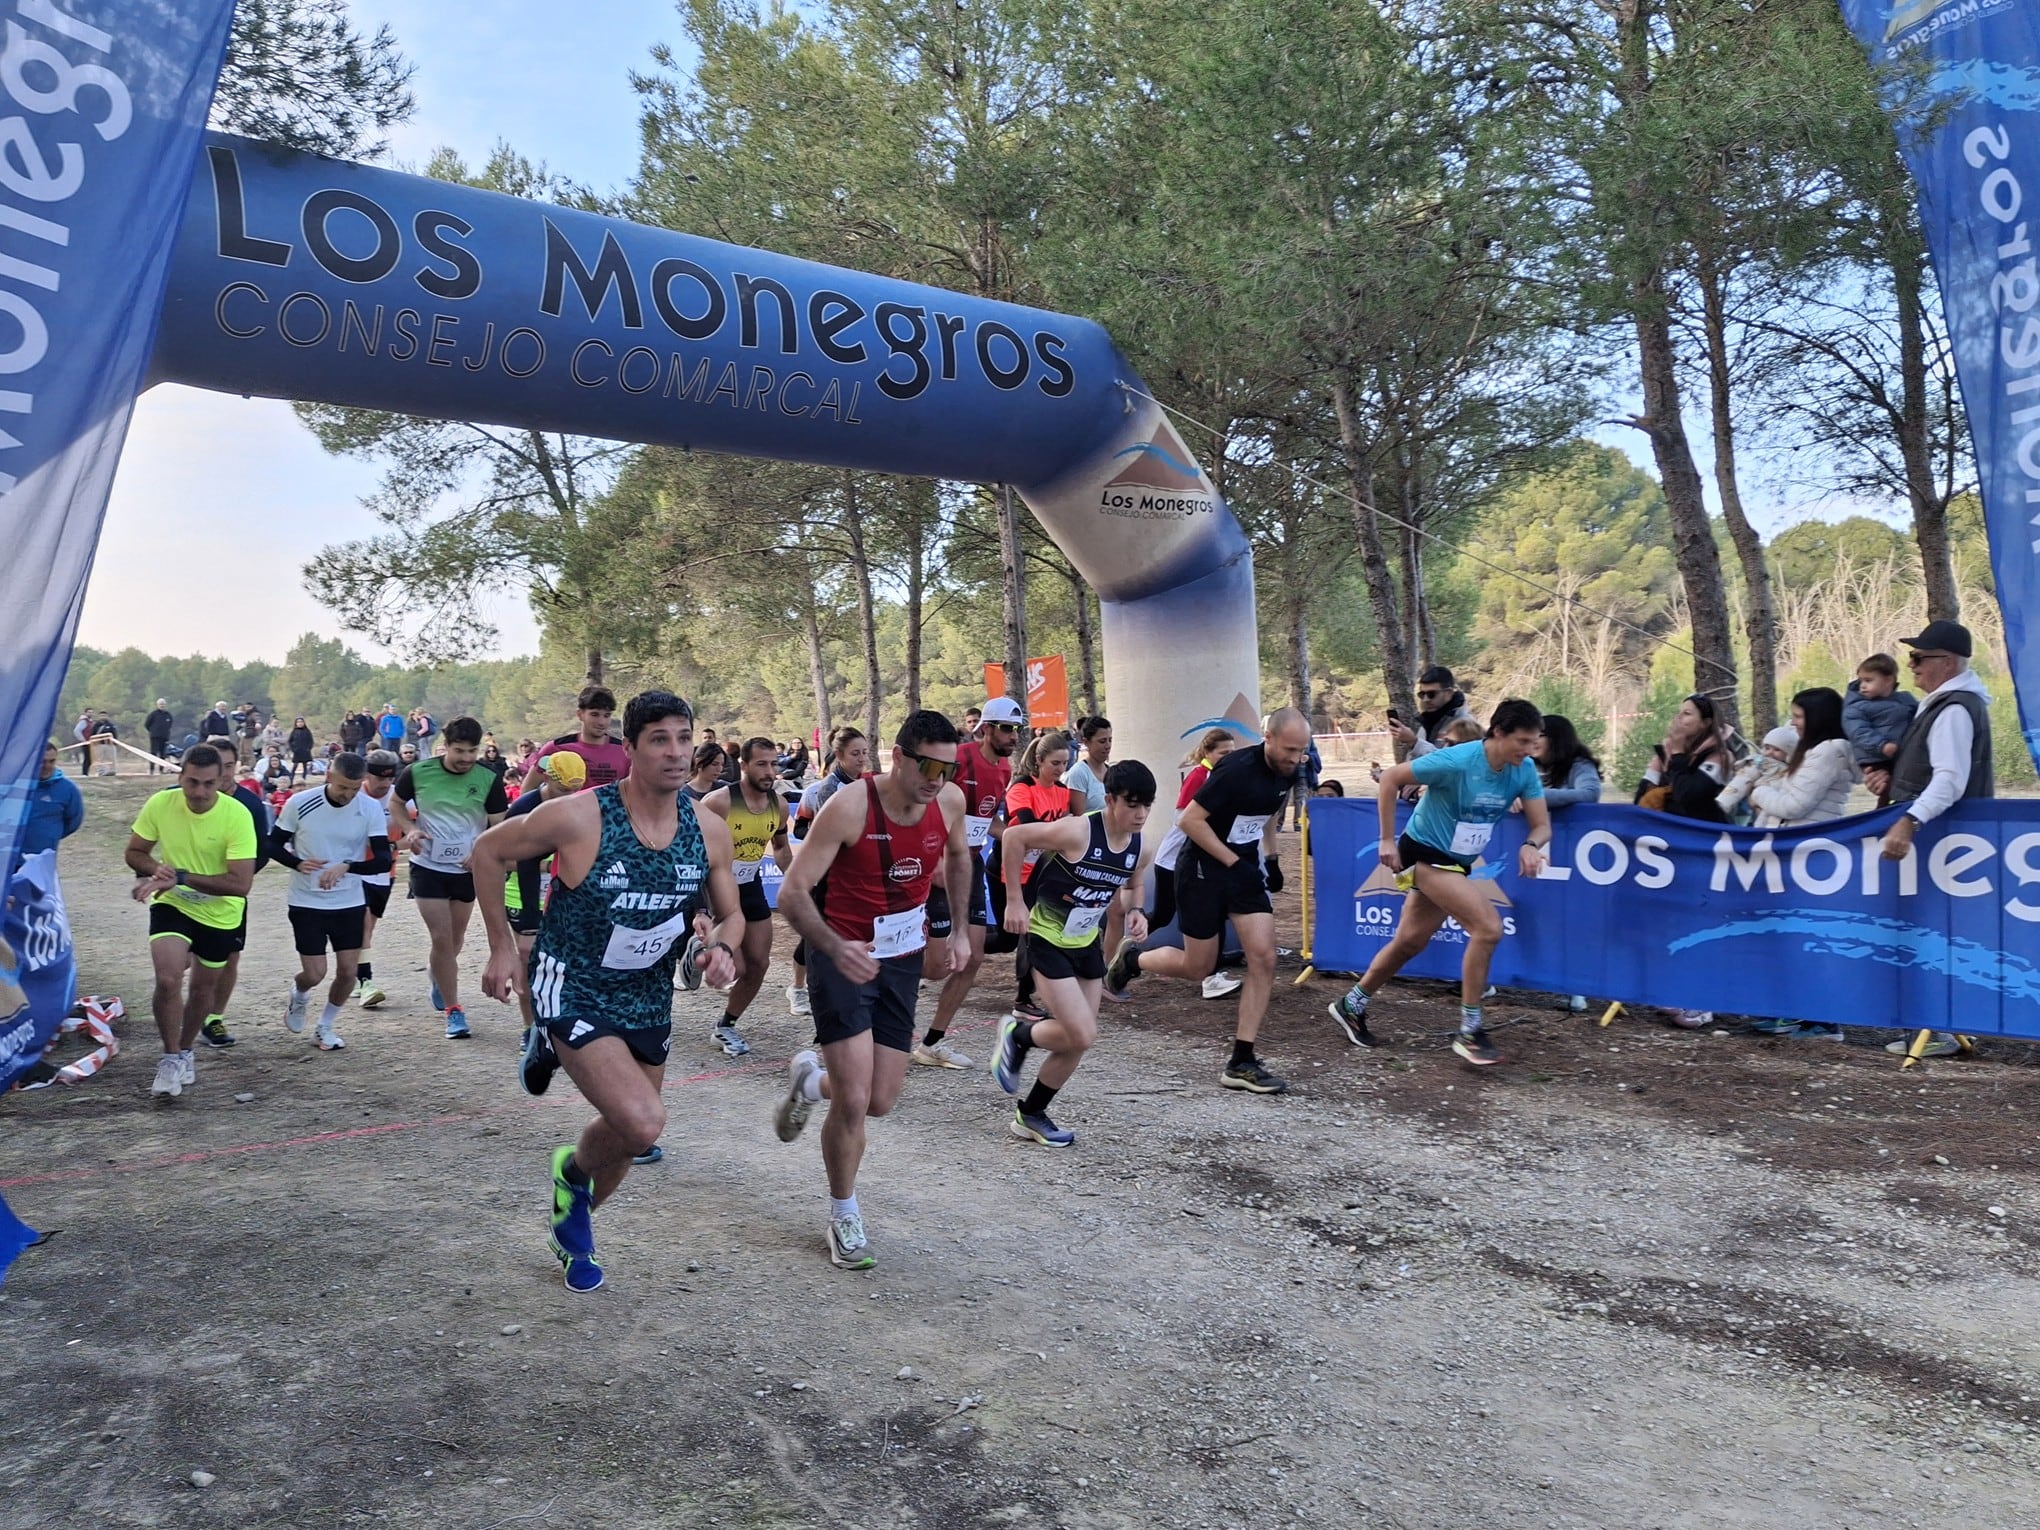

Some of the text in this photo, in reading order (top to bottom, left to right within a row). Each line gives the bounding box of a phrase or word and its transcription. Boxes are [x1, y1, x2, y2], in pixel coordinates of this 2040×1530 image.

[538, 215, 1075, 400] Monegros
[214, 281, 863, 425] CONSEJO COMARCAL
[1099, 507, 1140, 519] CONSEJO
[1139, 495, 1213, 516] Monegros
[971, 826, 986, 838] 57
[1471, 834, 1482, 845] 11
[444, 847, 460, 857] 60
[610, 891, 688, 910] ATLEET
[1355, 925, 1398, 938] CONSEJ
[633, 937, 663, 956] 45
